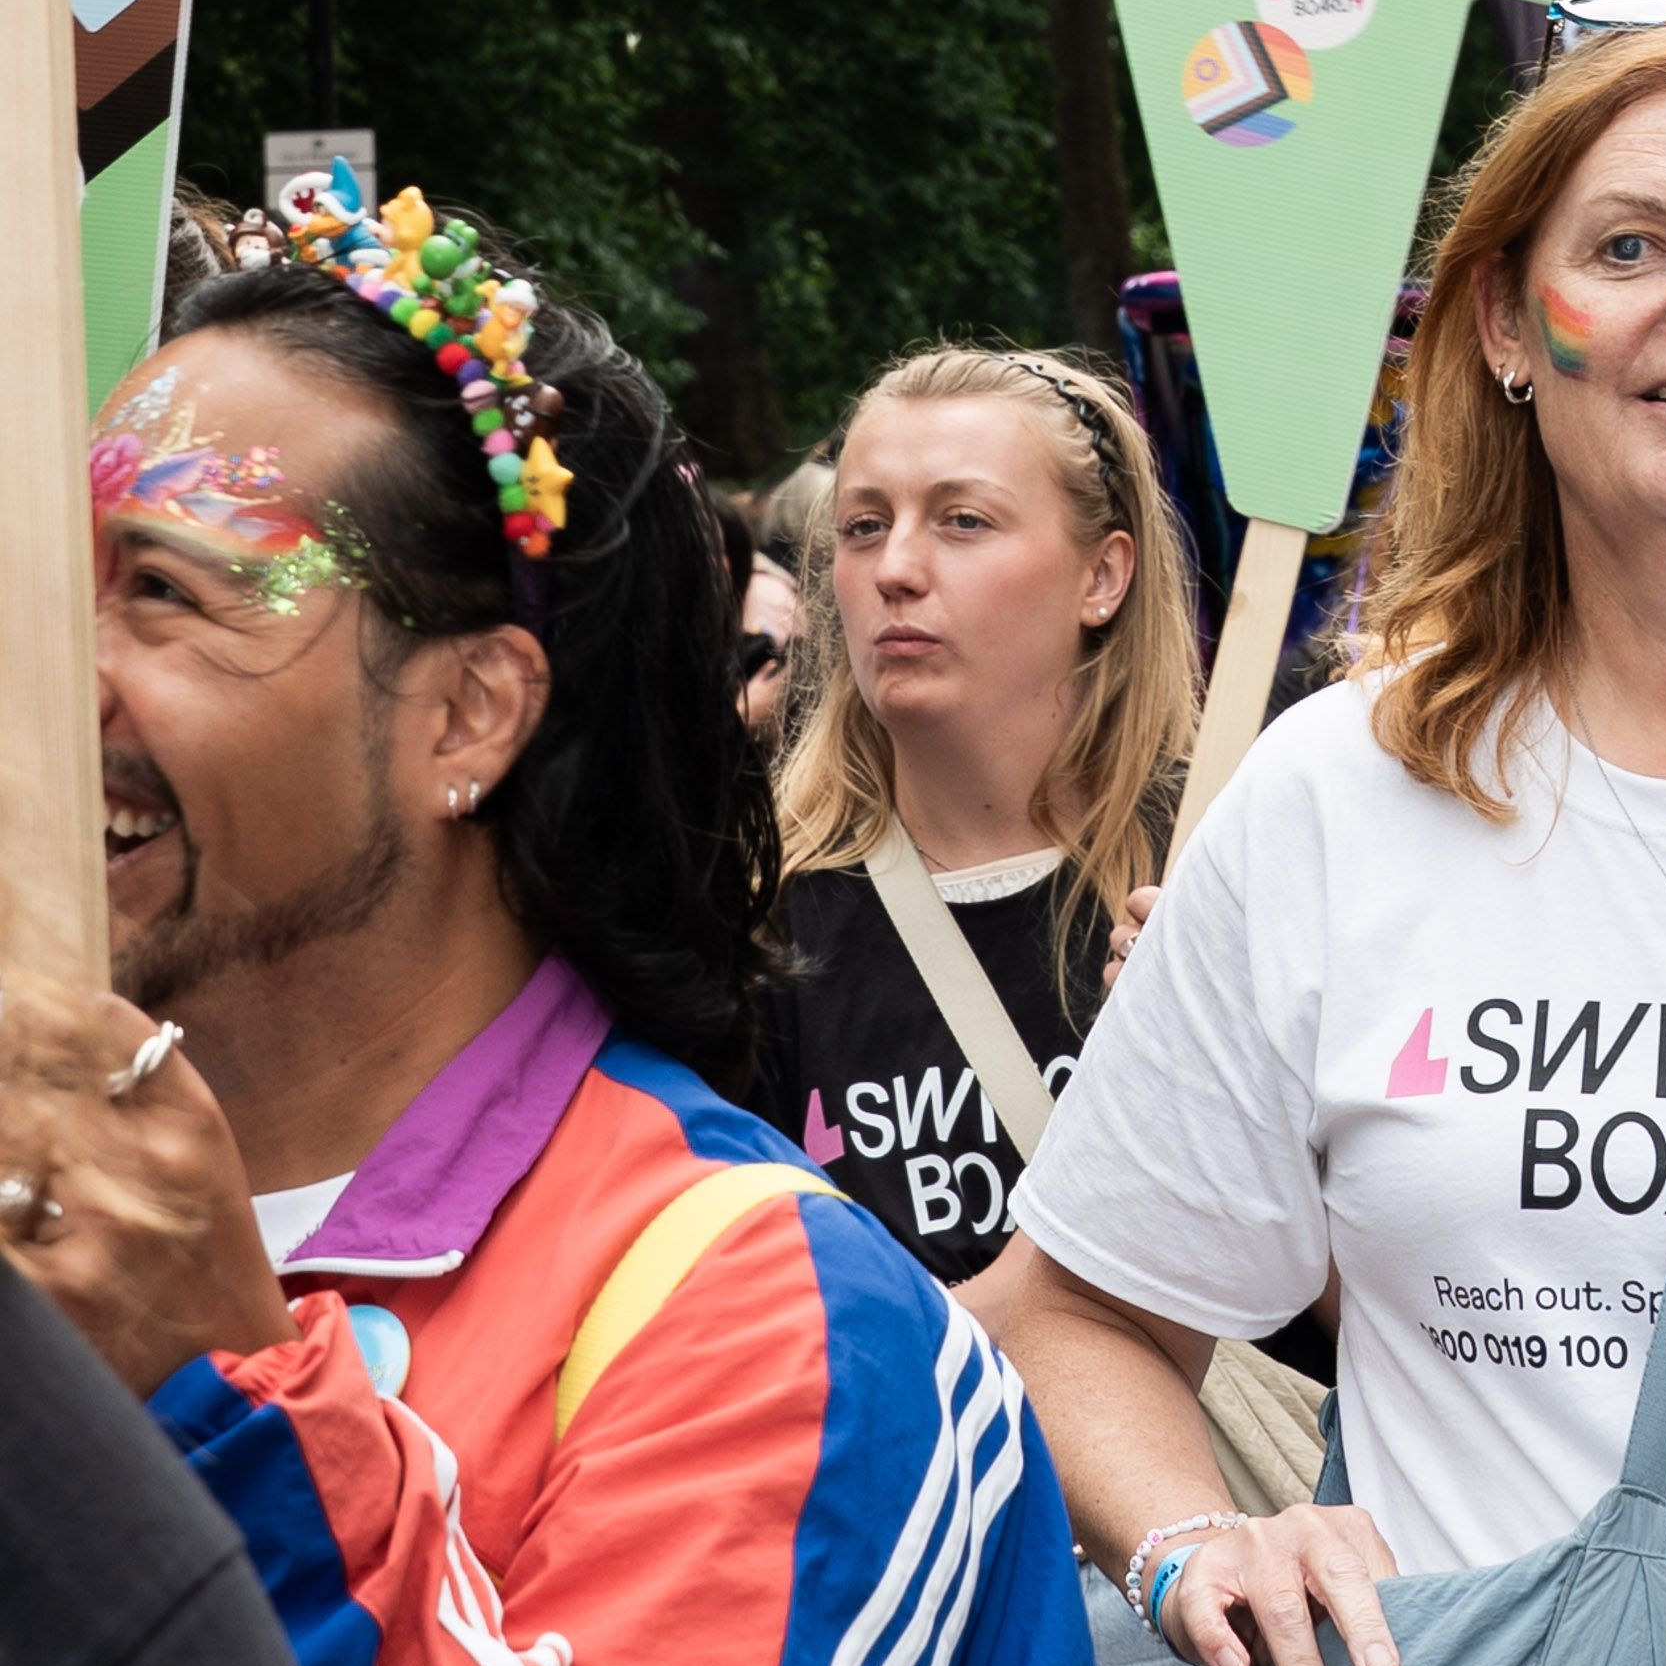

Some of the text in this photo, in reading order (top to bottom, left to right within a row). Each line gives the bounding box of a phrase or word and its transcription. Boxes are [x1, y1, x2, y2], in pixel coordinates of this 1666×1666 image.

[905, 1152, 1019, 1235] BO
[1433, 1275, 1524, 1312] Reach
[1535, 1280, 1612, 1313] out.
[1484, 1334, 1548, 1370] 0119
[1558, 1335, 1629, 1370] 100
